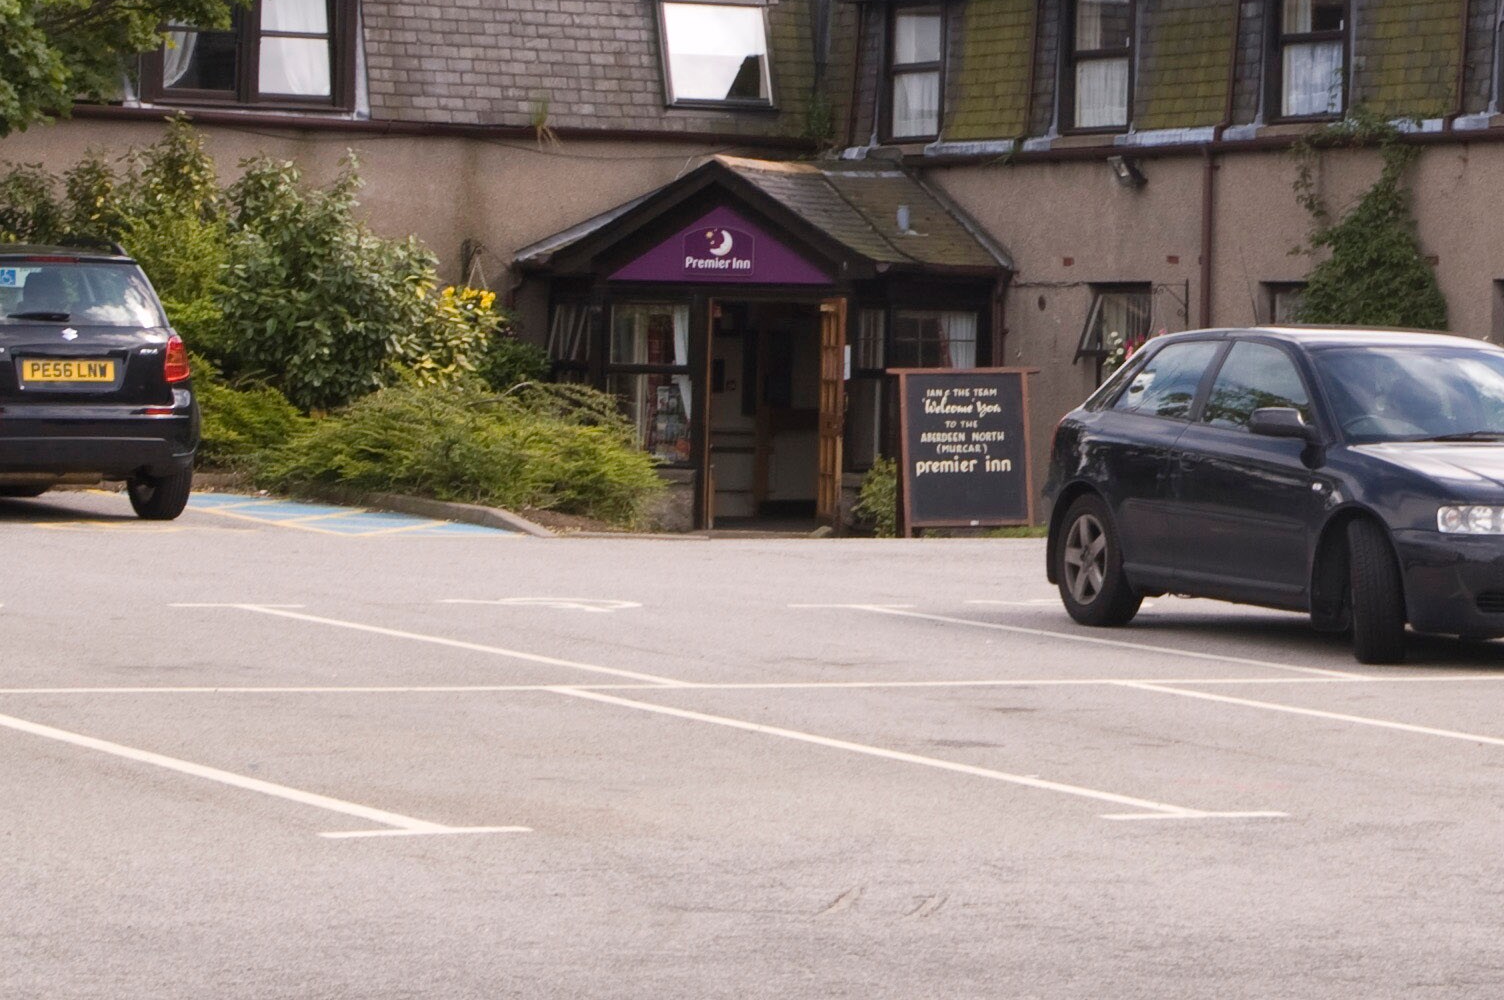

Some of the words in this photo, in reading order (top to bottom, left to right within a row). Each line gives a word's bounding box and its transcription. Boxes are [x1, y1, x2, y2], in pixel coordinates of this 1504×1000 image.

[685, 256, 731, 269] Premier
[732, 257, 751, 269] Inn
[31, 362, 73, 378] PE56
[77, 362, 108, 378] LNW
[926, 389, 943, 397] IAN
[953, 388, 970, 397] THE
[973, 388, 997, 397] TEAM
[945, 420, 957, 428] TO
[960, 420, 978, 428] THE
[920, 432, 966, 443] ABERDEEN
[972, 431, 1004, 441] NORTH
[936, 443, 988, 454] (MURCAR)
[916, 455, 977, 477] premier
[985, 455, 1012, 473] inn
